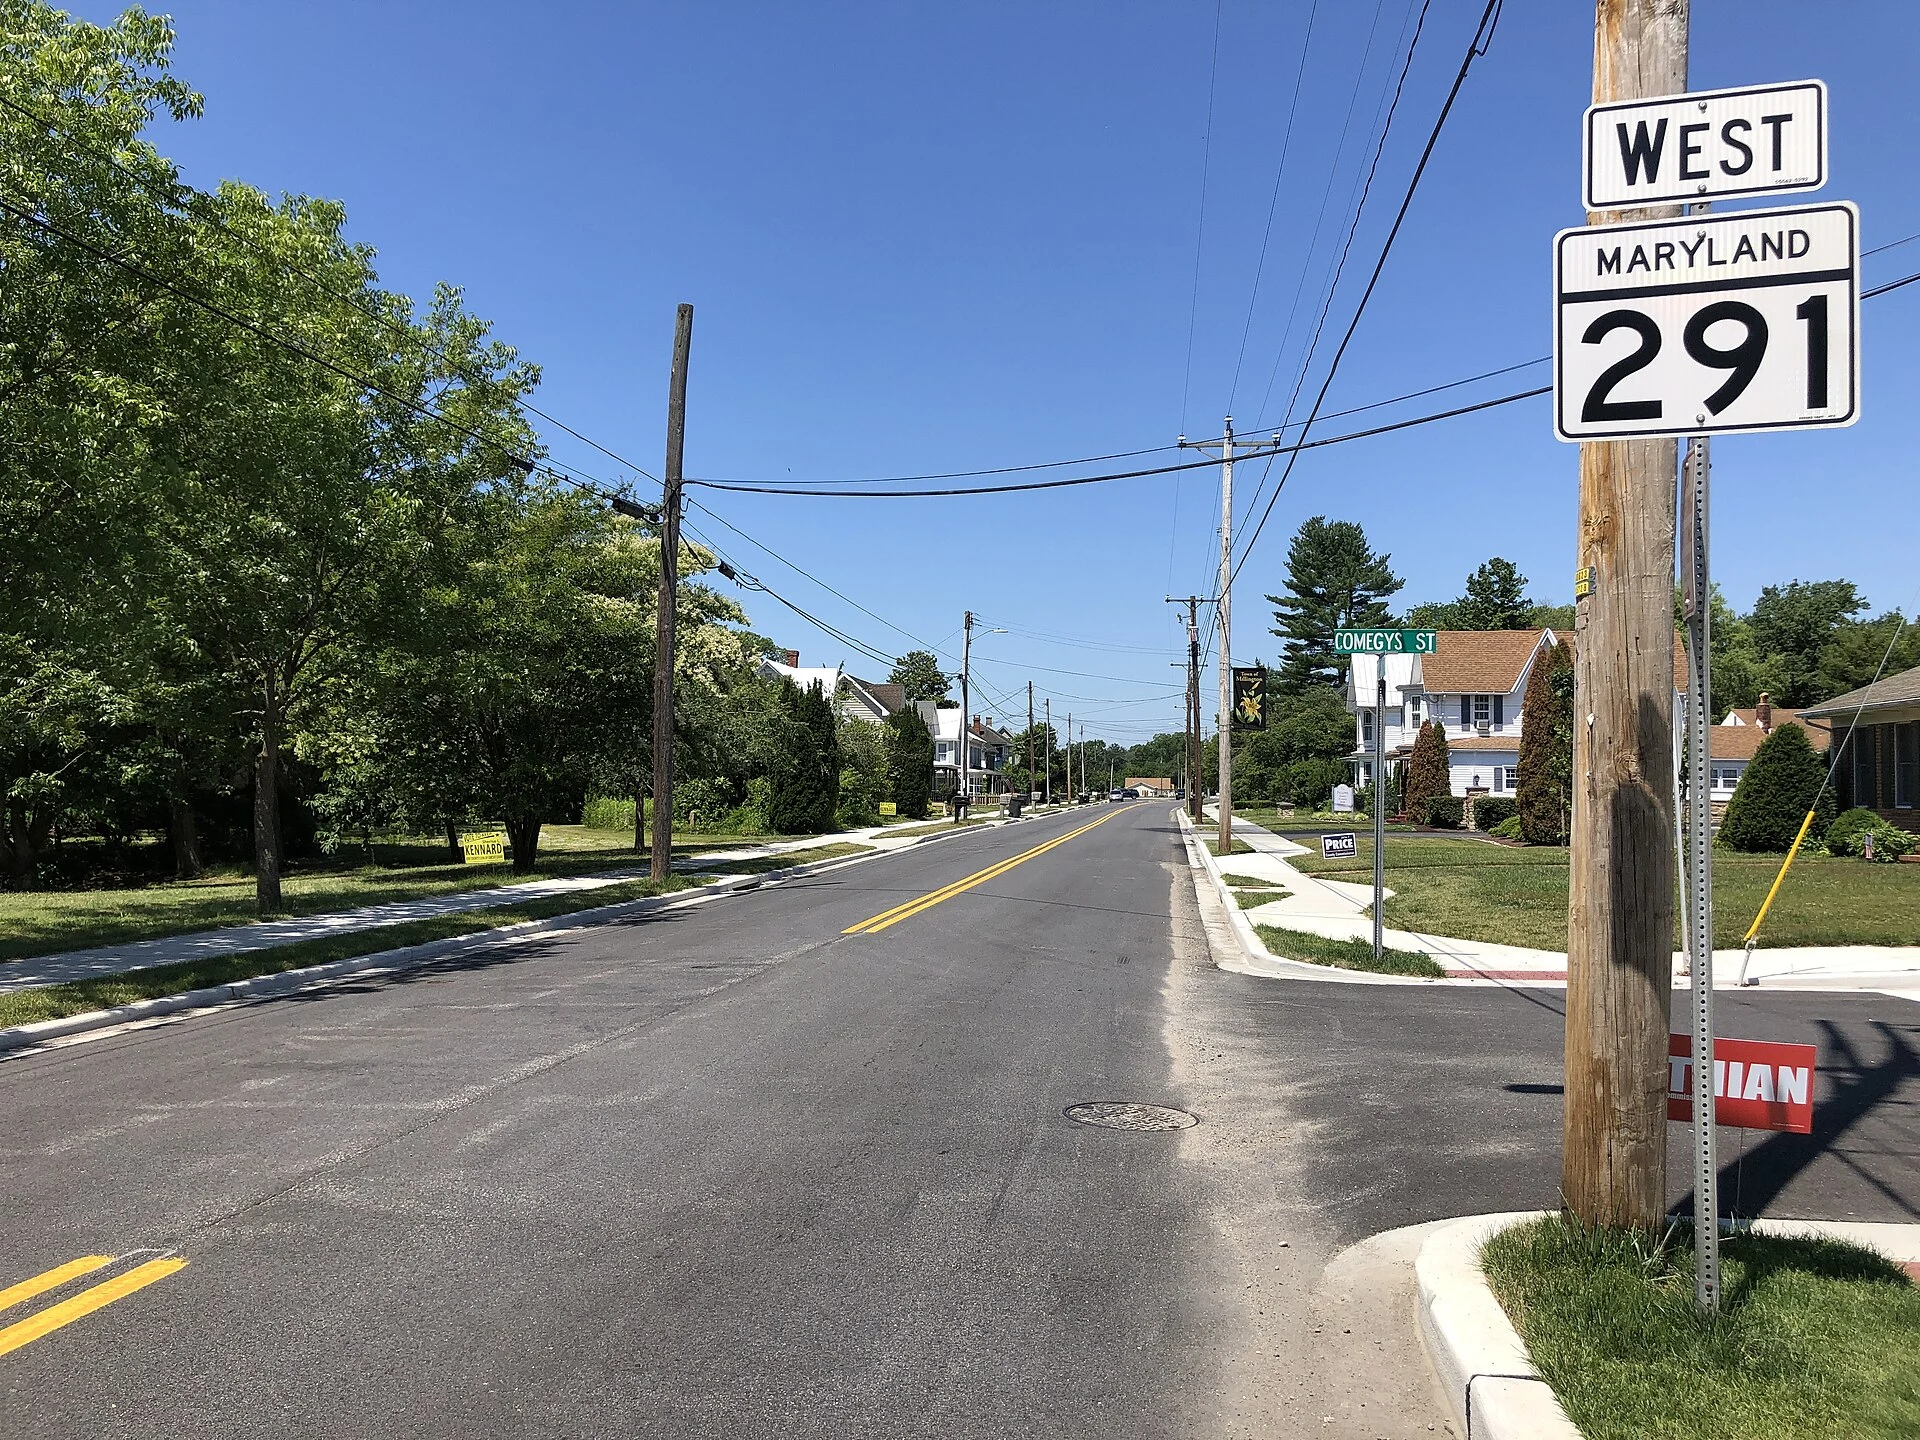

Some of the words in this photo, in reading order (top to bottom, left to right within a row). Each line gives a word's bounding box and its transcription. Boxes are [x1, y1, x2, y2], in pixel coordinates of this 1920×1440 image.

[1616, 113, 1793, 187] WEST
[1597, 229, 1810, 276] MARYLAND
[1581, 294, 1828, 423] 291
[1335, 632, 1402, 651] COMEGYS
[1415, 632, 1436, 651] ST
[465, 843, 502, 855] KENNARD
[1325, 838, 1353, 850] PRICE
